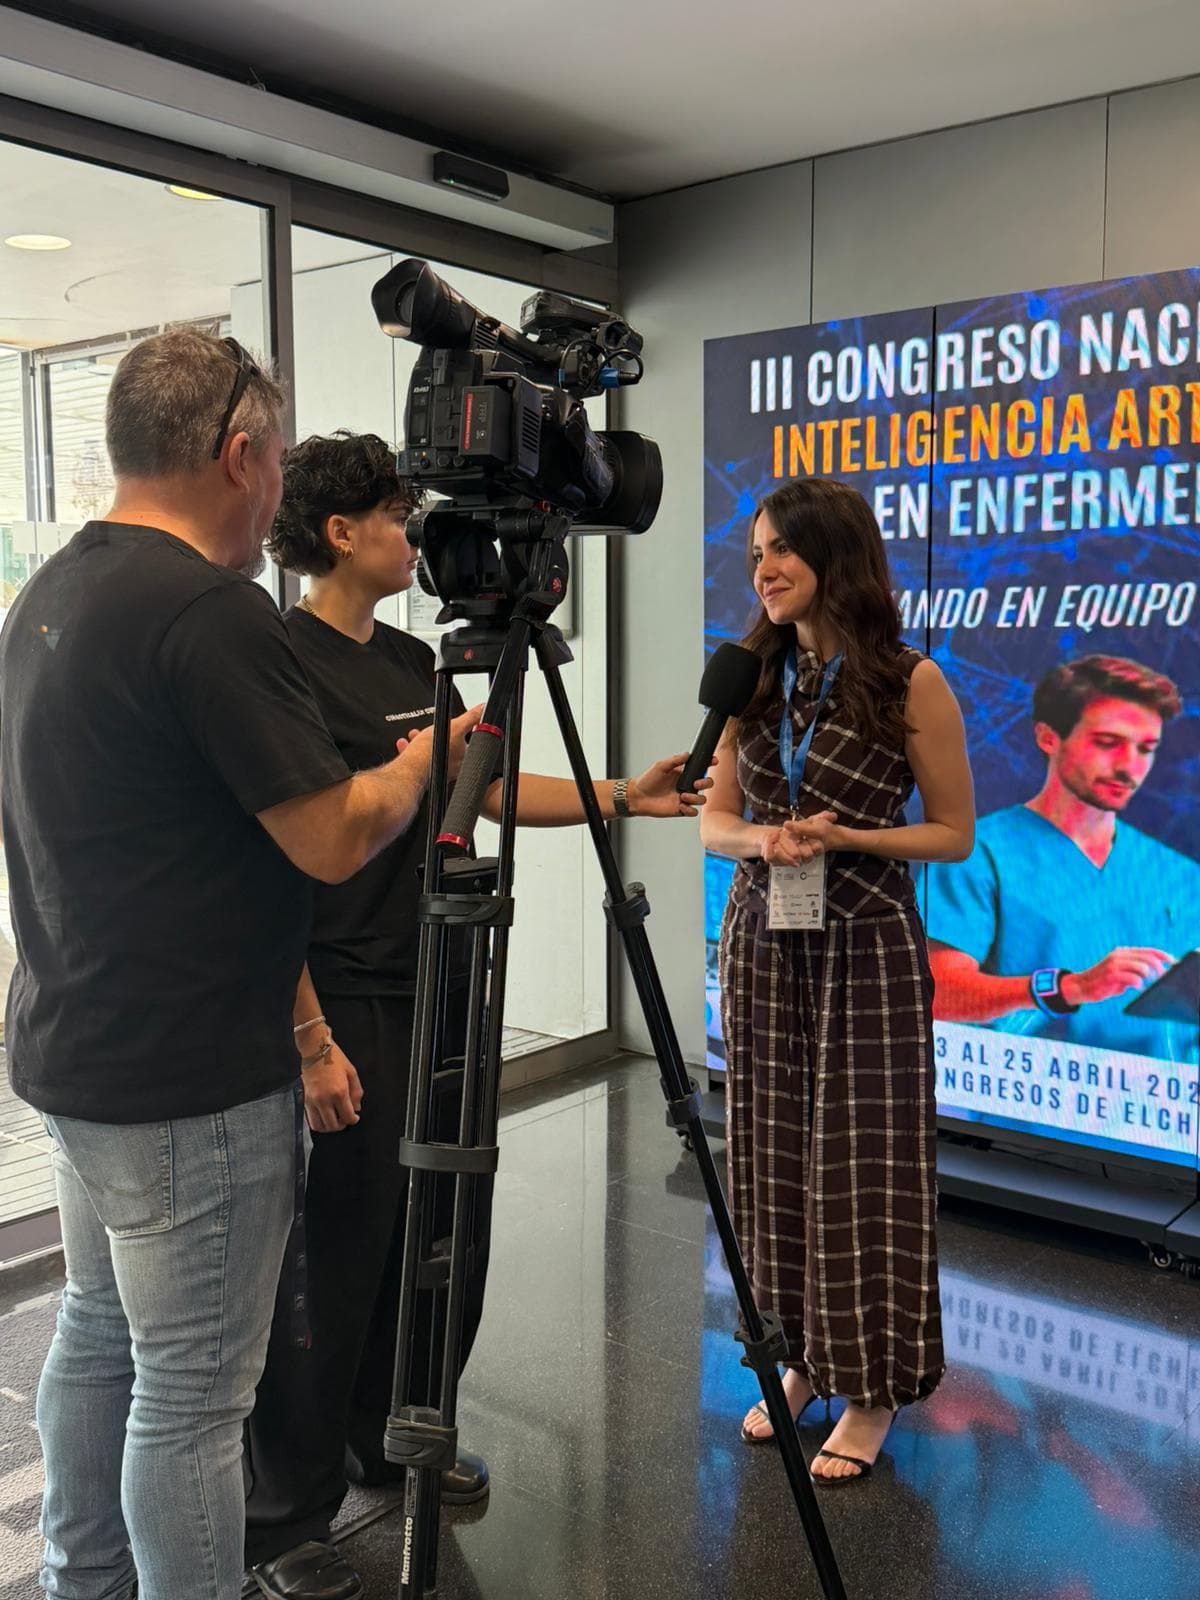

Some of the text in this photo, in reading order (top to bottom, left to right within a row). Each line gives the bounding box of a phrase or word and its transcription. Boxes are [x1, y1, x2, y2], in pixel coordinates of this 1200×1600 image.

[749, 355, 793, 414] III
[807, 319, 1061, 407] CONGRESO
[772, 382, 1200, 479] INTELIGENCIA ART
[874, 482, 929, 540] EN
[891, 581, 1197, 635] ANDO EN EQUIPO
[936, 1036, 947, 1058] 3
[962, 1041, 989, 1066] AL
[1004, 1048, 1033, 1073] 25
[1050, 1057, 1131, 1092] ABRIL
[944, 1066, 1191, 1136] NGRESOS DE ELCH
[400, 1516, 414, 1585] Manfrotto
